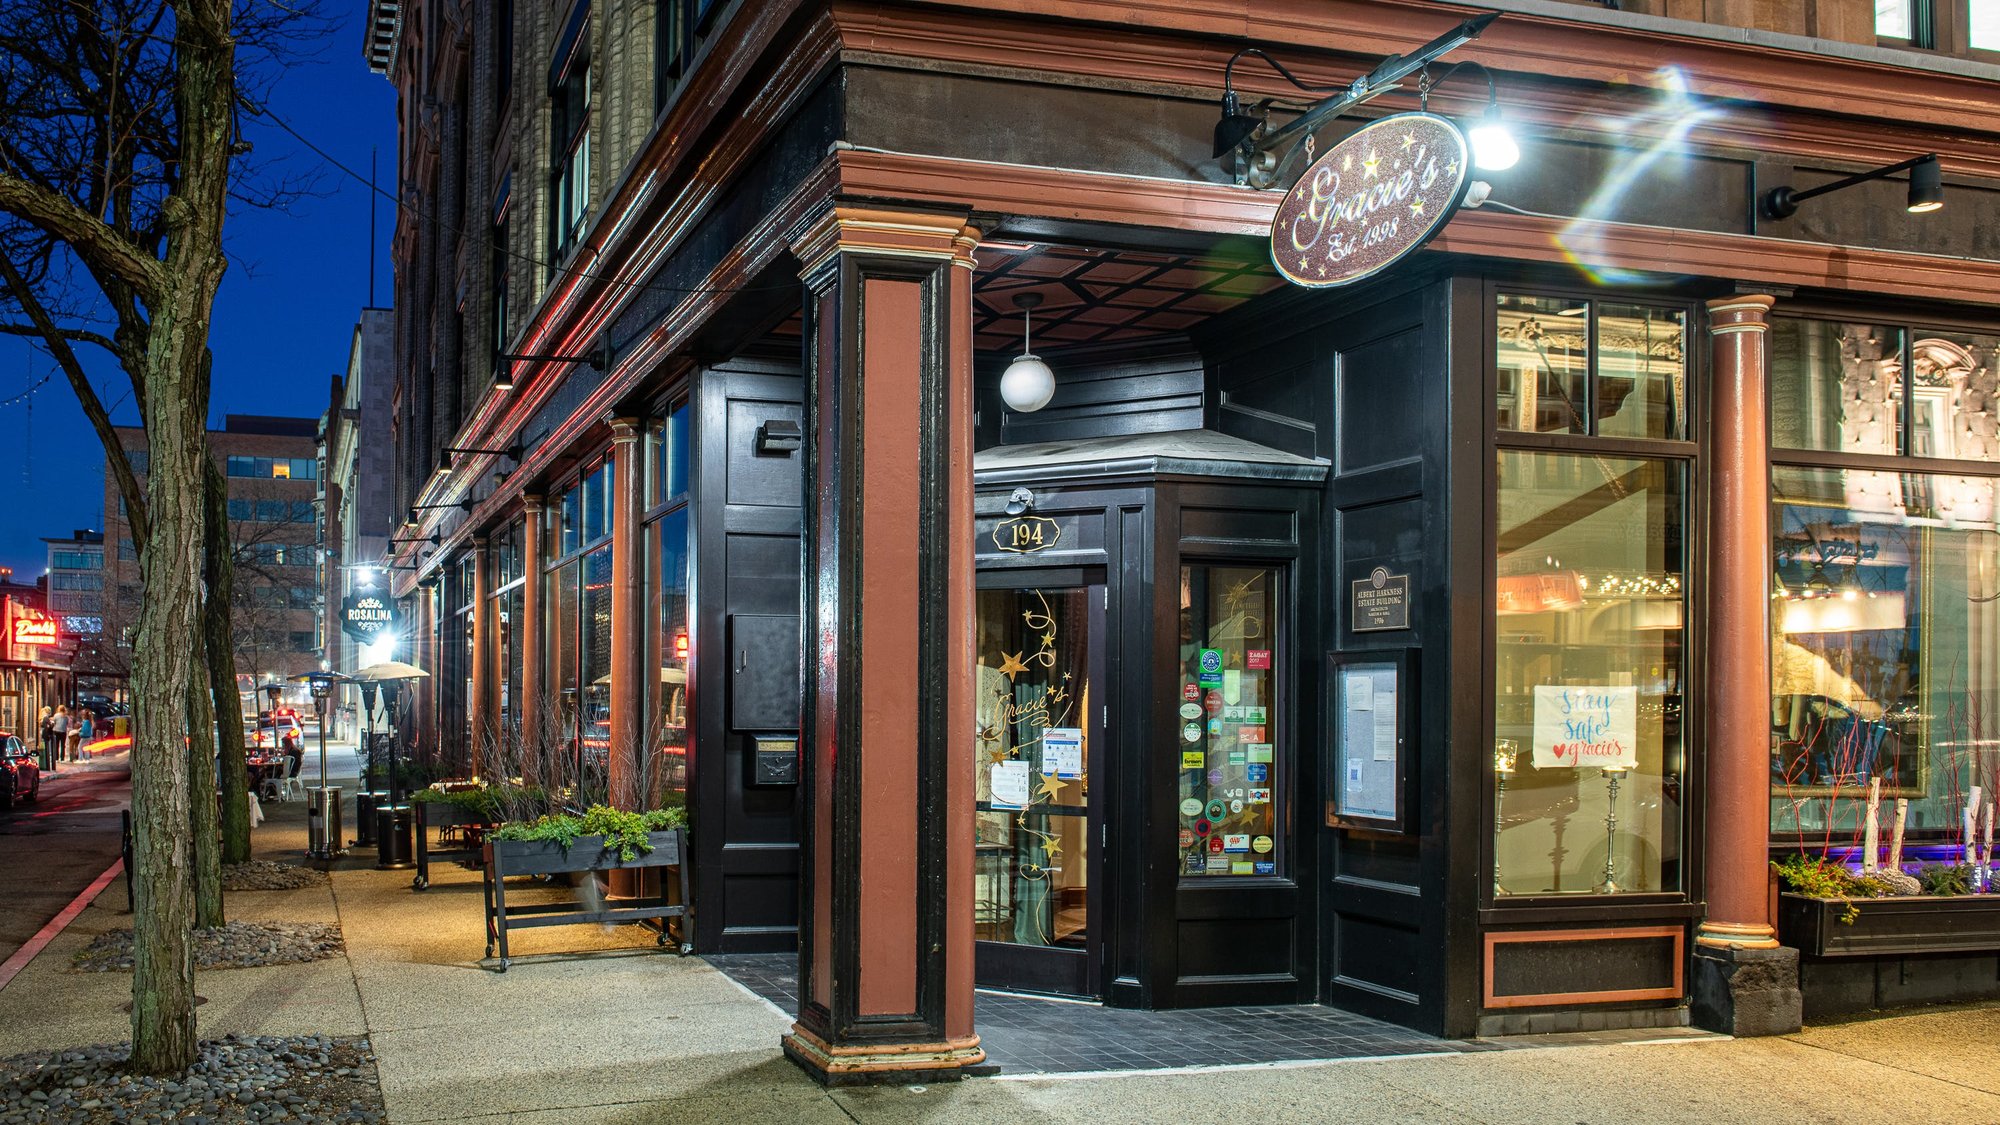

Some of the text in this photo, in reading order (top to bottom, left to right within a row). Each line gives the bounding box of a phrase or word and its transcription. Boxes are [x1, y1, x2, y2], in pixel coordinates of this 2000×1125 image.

[1292, 144, 1439, 251] Gracie's
[1326, 217, 1399, 262] Est. 1998
[1011, 523, 1044, 546] 194
[348, 609, 392, 621] ROSALINA
